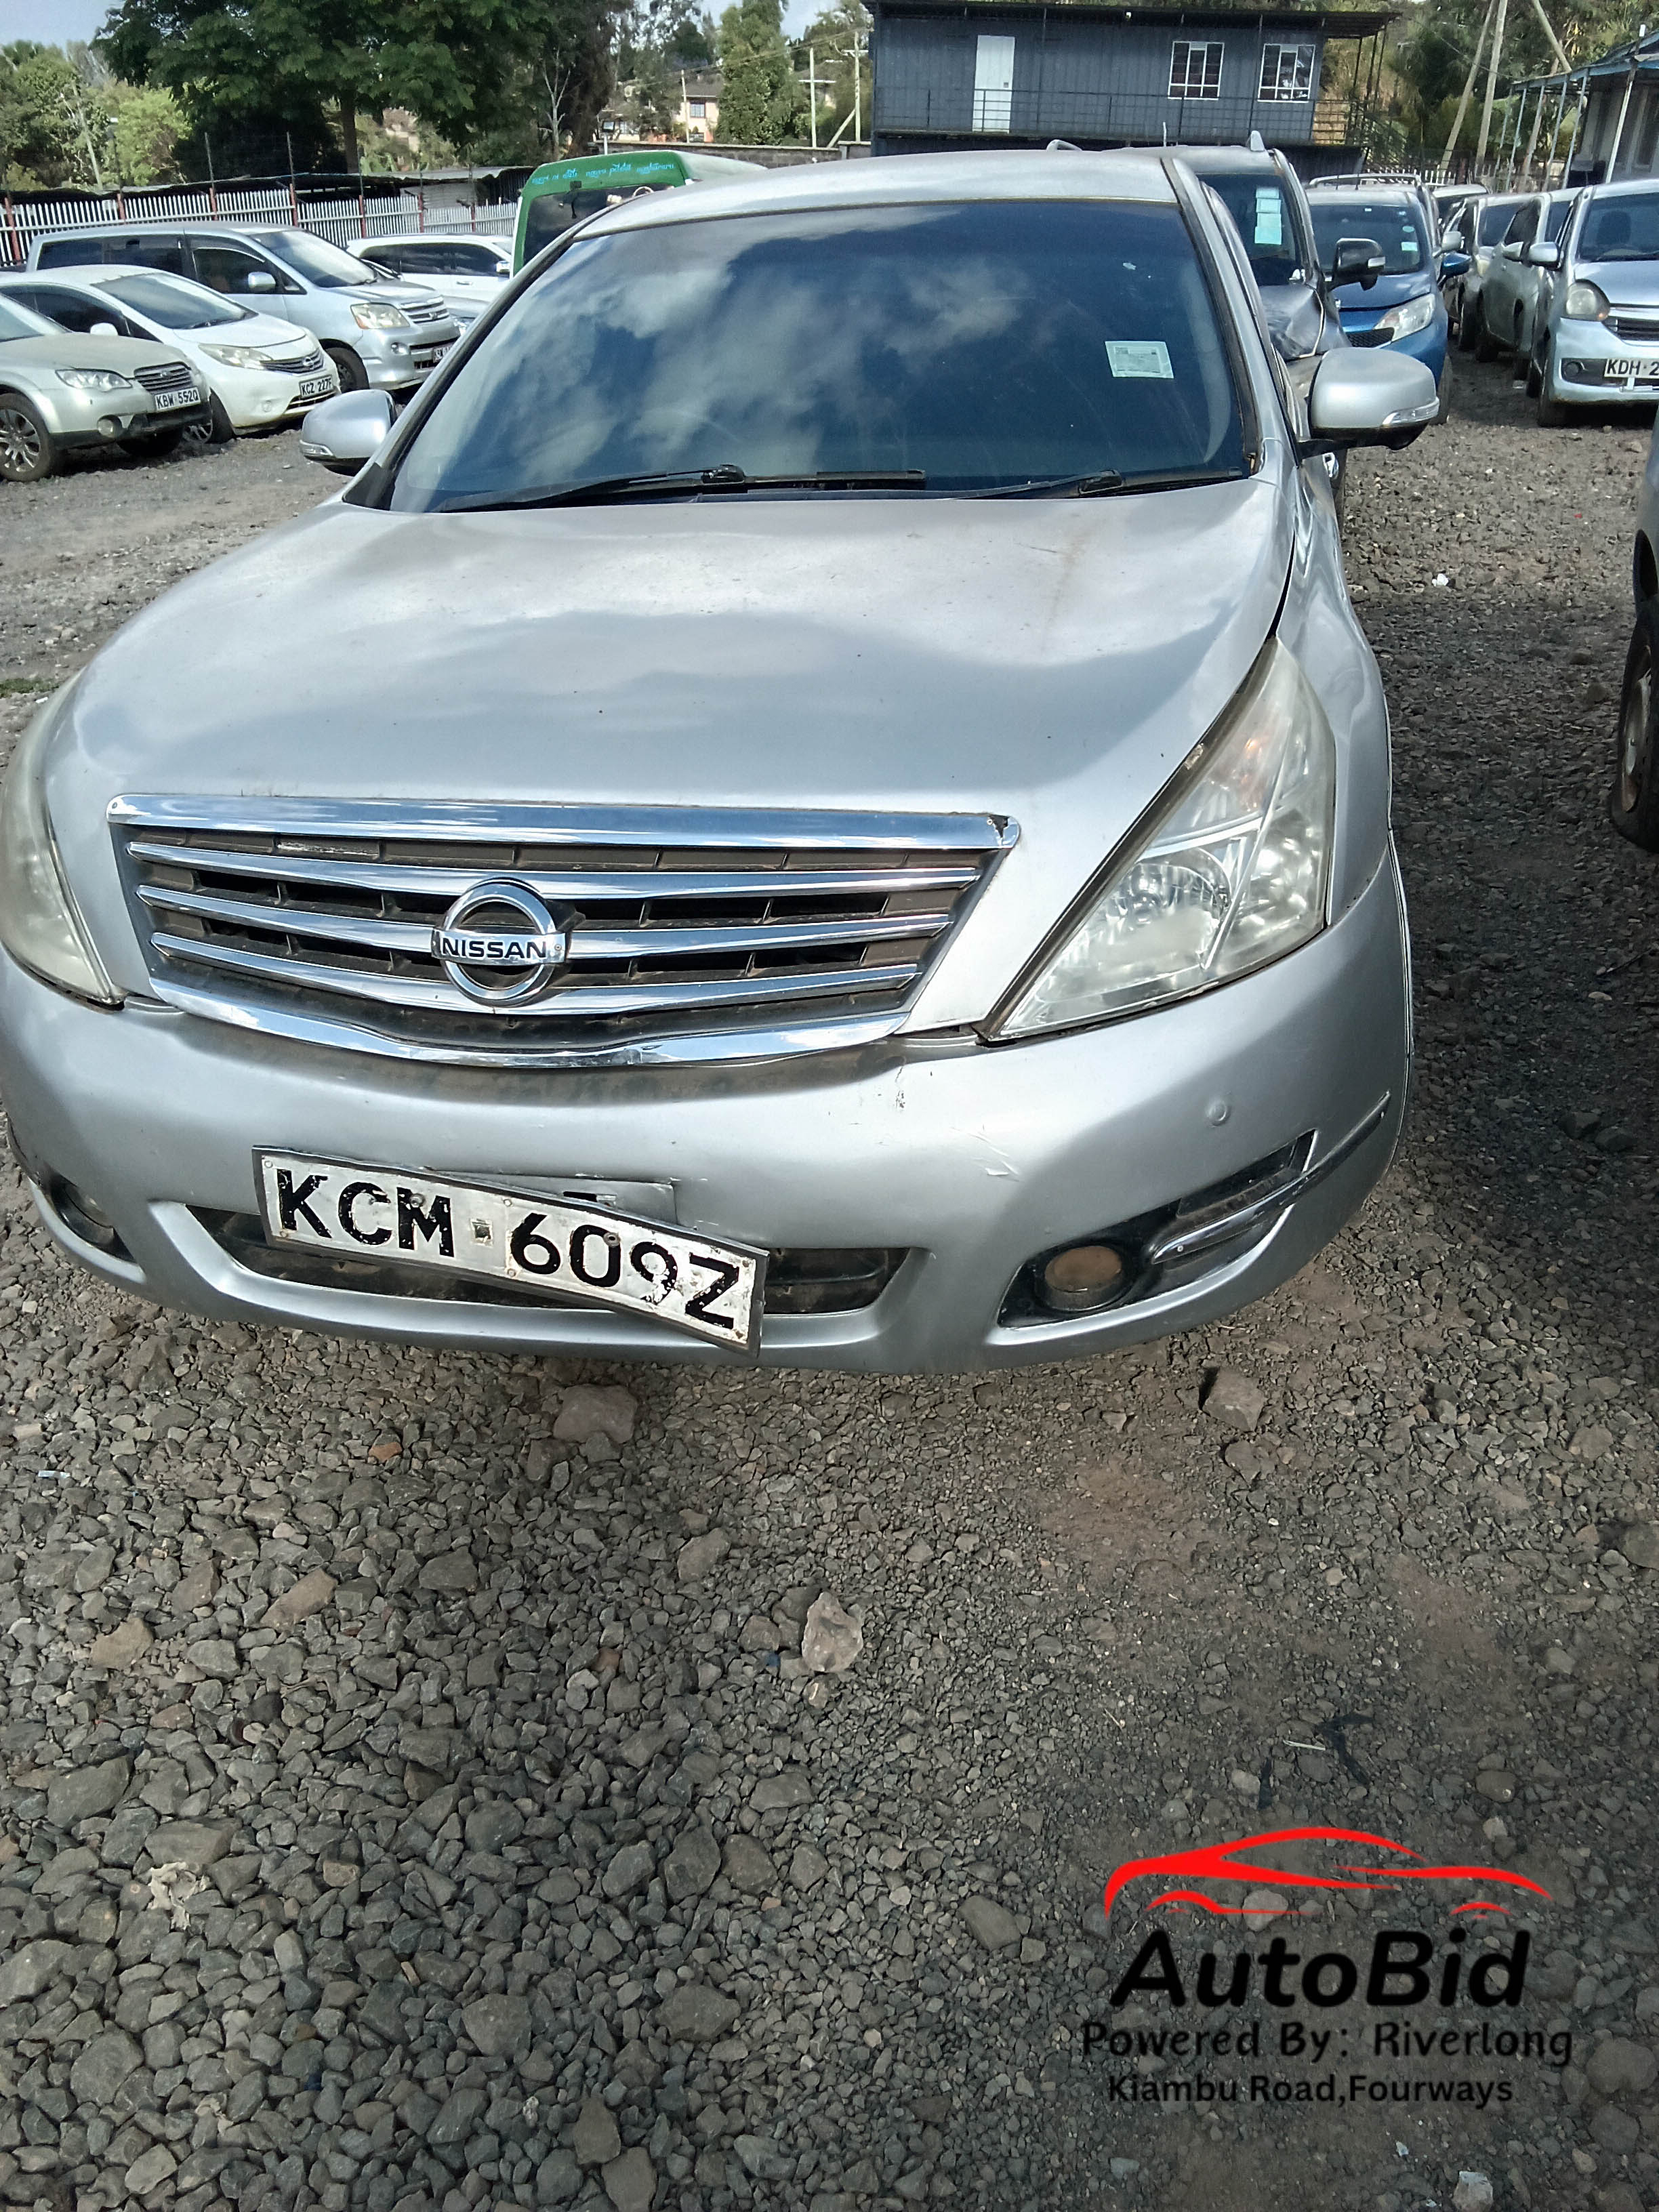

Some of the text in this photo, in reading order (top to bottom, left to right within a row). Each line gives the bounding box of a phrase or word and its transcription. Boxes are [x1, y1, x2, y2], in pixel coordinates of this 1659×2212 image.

[1607, 359, 1641, 375] KDH
[302, 377, 332, 396] KCZ 227F
[157, 389, 199, 409] KBW 552Q
[443, 937, 546, 959] NISSAN
[276, 1168, 741, 1329] KCM 609Z
